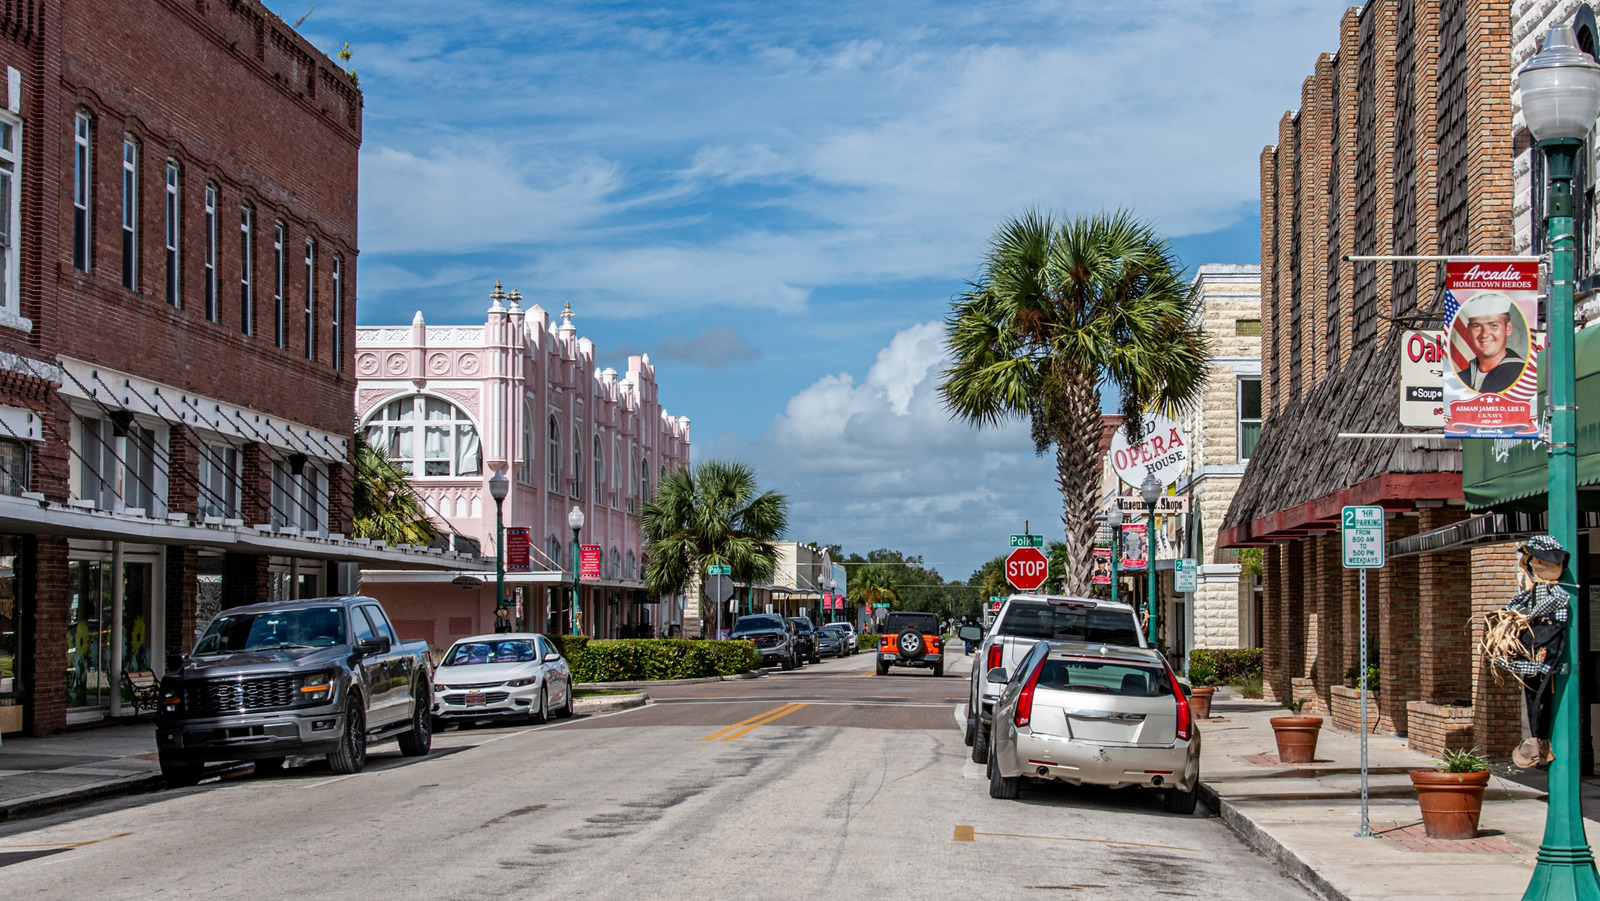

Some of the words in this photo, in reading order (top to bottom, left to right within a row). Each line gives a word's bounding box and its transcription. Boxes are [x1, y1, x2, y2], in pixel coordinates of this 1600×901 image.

[1462, 264, 1521, 280] Arcadia
[1418, 388, 1437, 400] Soup
[1114, 427, 1184, 470] OPERA
[1144, 451, 1186, 474] HOUSE
[1161, 498, 1182, 512] Shops
[1346, 511, 1354, 526] 2
[1011, 536, 1032, 546] Polk
[1009, 560, 1045, 577] STOP
[1176, 561, 1182, 570] 2
